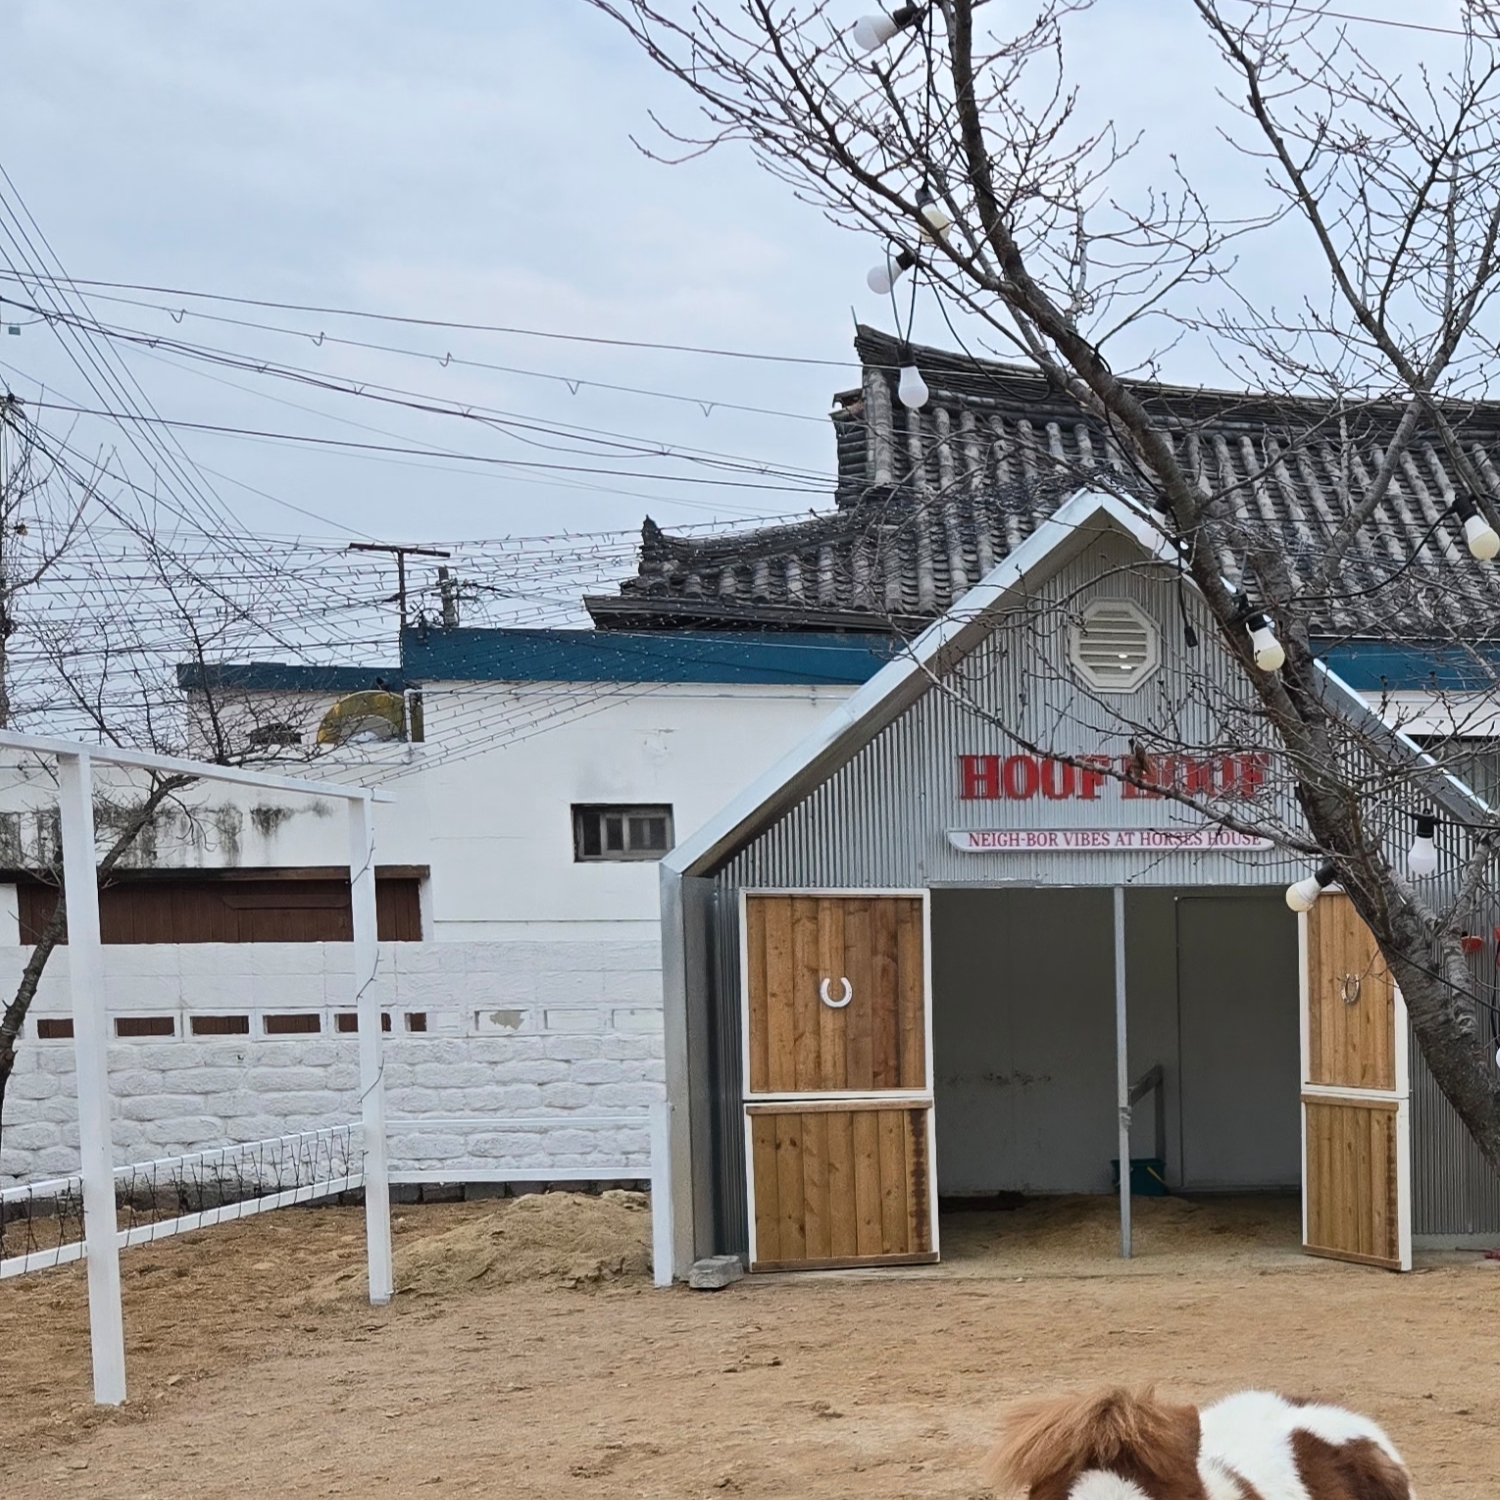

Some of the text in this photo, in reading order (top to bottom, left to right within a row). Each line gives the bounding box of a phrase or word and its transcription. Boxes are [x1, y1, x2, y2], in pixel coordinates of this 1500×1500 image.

[959, 754, 1111, 801] HOOF
[968, 831, 1262, 848] NEIGH-BOR VIBES AT HORSES HOUSE
